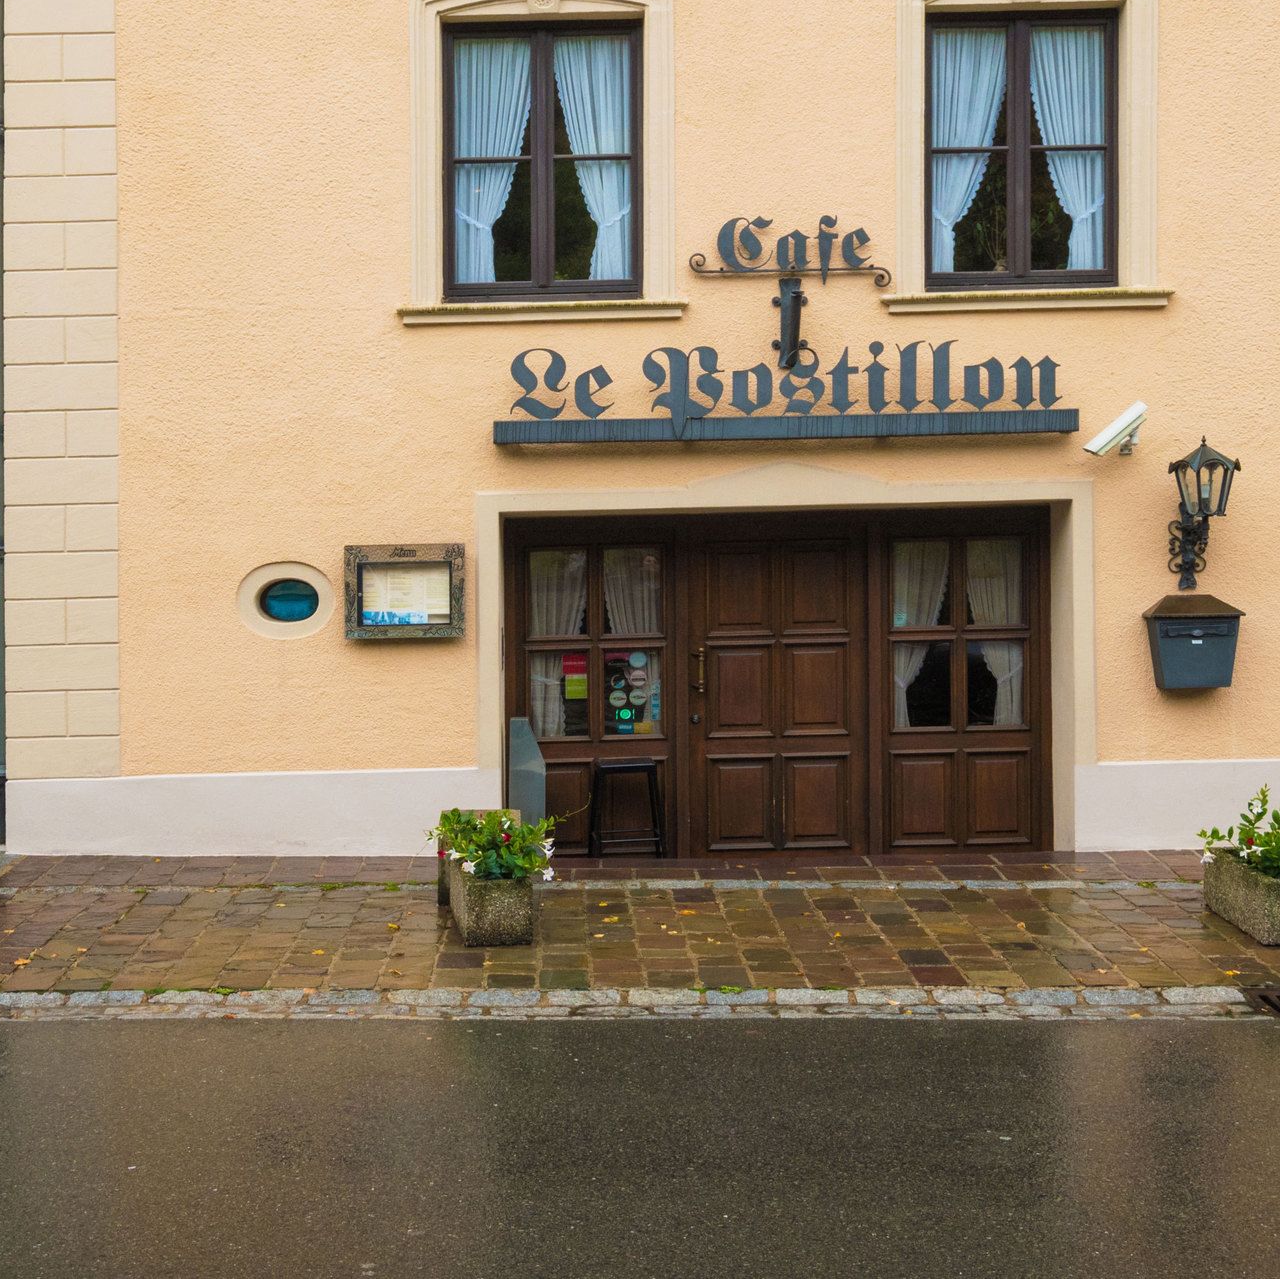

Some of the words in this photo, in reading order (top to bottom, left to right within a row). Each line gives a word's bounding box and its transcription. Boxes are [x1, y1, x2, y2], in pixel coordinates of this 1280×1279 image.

[717, 214, 872, 286] Cafe
[510, 347, 615, 421] Le
[642, 339, 1064, 441] Postillon
